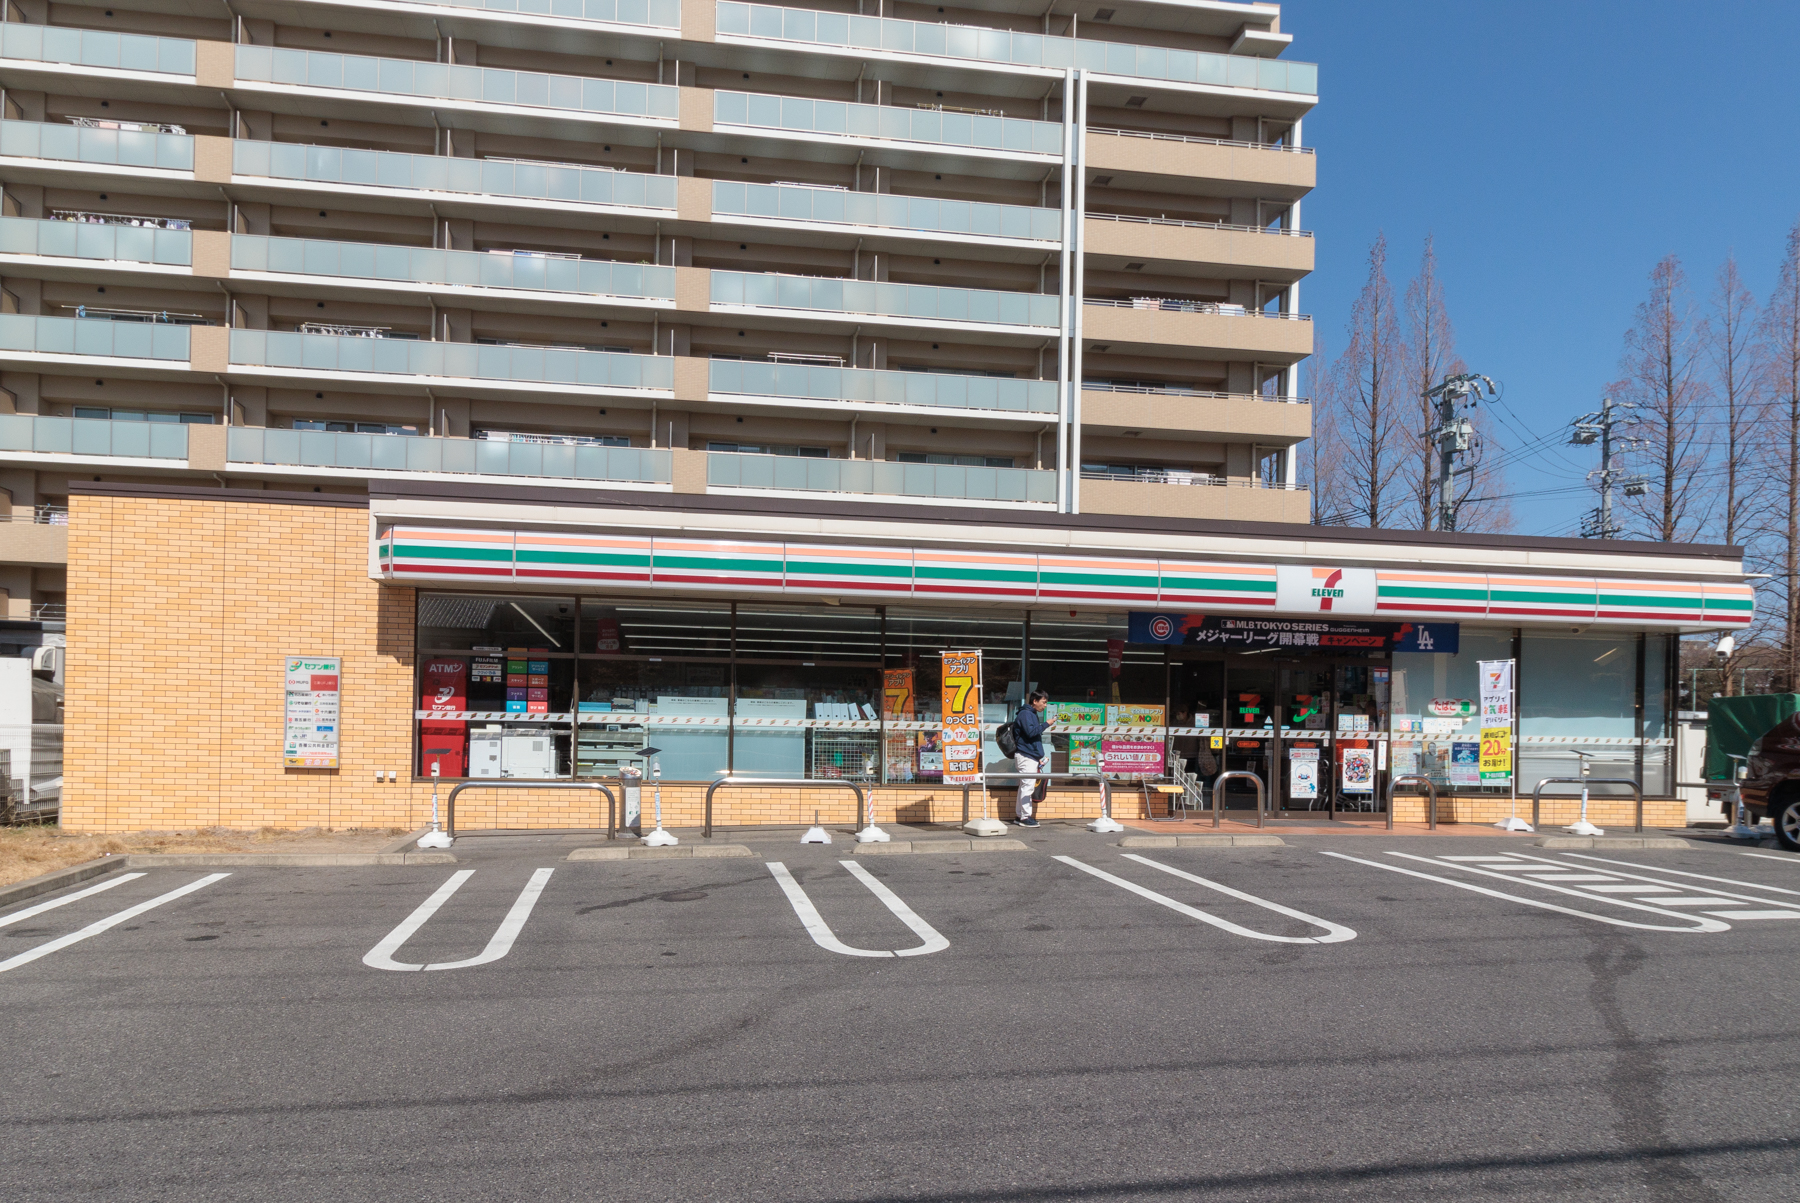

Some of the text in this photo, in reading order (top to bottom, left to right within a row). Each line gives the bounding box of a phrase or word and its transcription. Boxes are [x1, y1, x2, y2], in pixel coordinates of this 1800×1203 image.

[1312, 568, 1342, 611] 7
[1236, 621, 1330, 632] MLB TOKYO SERIES
[1195, 629, 1320, 647] メジャーリーグ開幕戦
[1326, 636, 1379, 645] キャンペーン
[949, 664, 969, 674] アプリ
[888, 679, 905, 687] アプリ
[945, 676, 974, 714] 7
[1434, 700, 1457, 711] たばこ
[1483, 704, 1508, 715] お気軽
[945, 713, 975, 725] のつく日
[1073, 713, 1100, 722] 7NOW
[1134, 714, 1160, 722] 7NOW
[1482, 740, 1508, 756] 20分
[949, 761, 974, 772] 配信中
